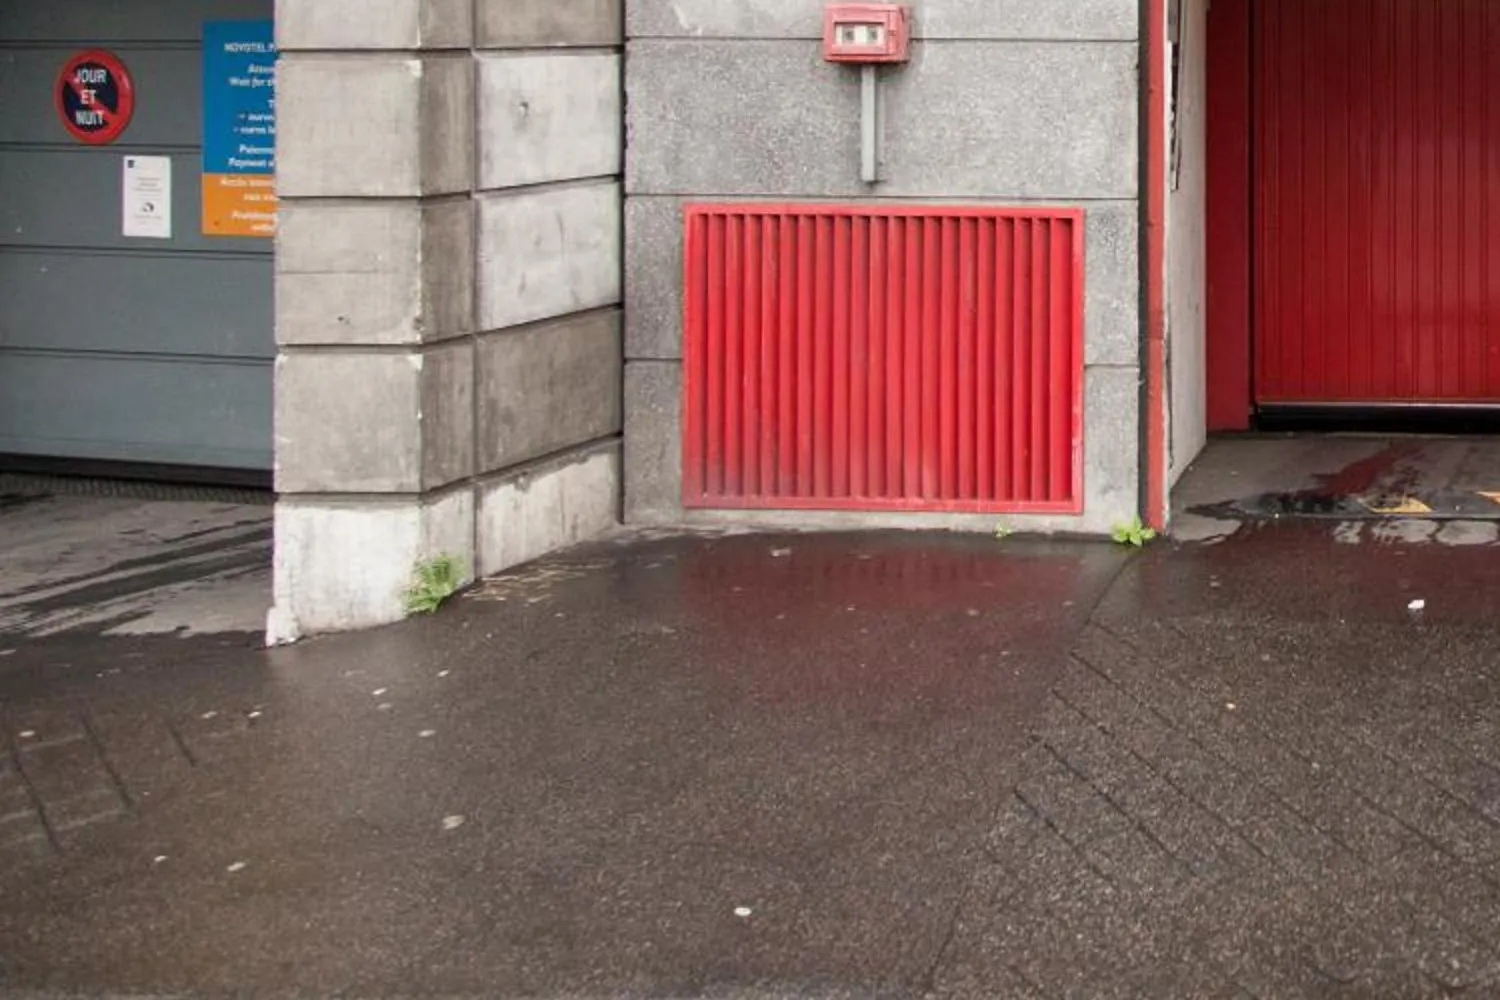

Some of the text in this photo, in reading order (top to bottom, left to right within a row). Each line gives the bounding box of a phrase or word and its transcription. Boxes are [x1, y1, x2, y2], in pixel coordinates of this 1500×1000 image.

[74, 69, 107, 84] JOUR
[81, 90, 96, 104] ET
[76, 110, 104, 125] NUIT
